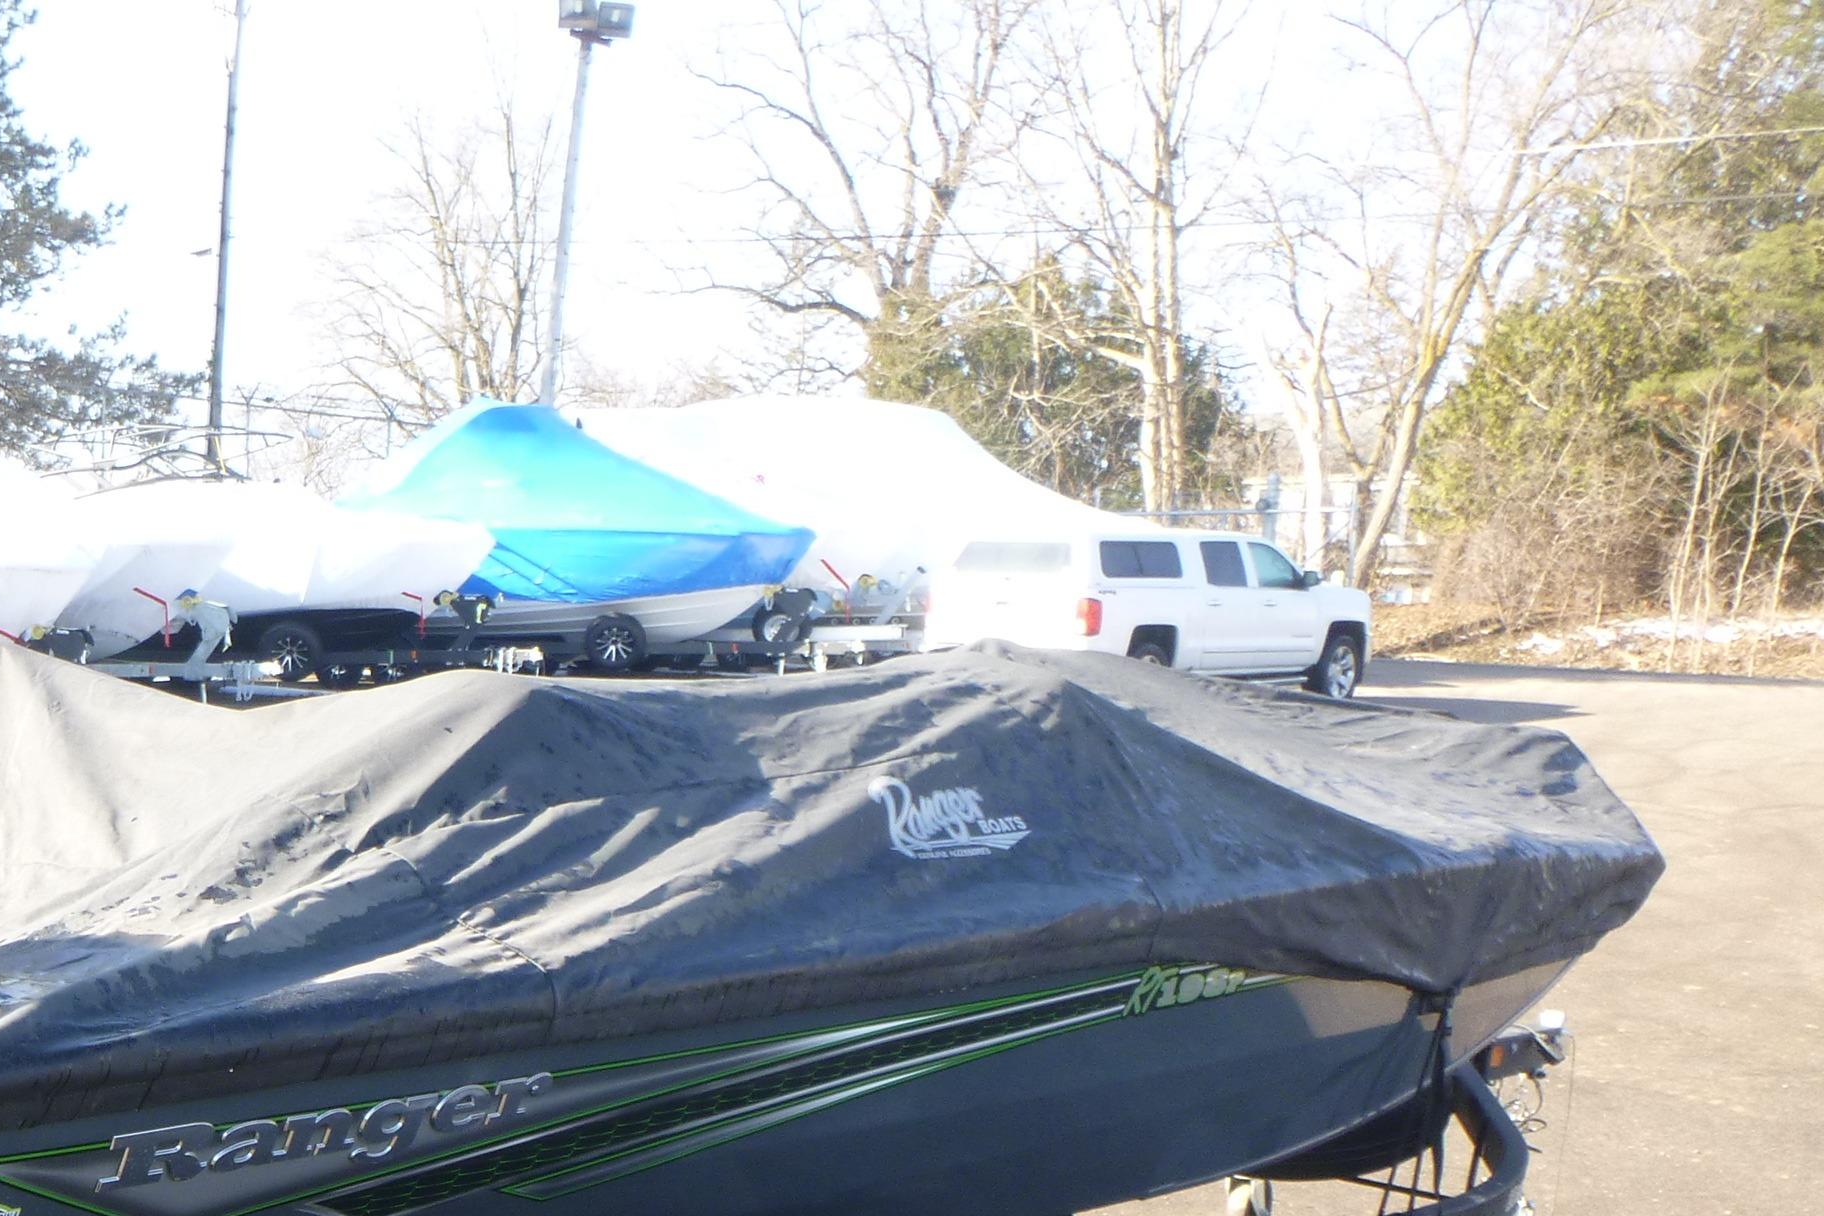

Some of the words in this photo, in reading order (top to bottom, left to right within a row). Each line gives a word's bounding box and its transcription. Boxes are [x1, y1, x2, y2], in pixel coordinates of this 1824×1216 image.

[867, 776, 985, 860] Ranger
[977, 816, 1027, 835] BOATS
[95, 1072, 554, 1193] Ranger
